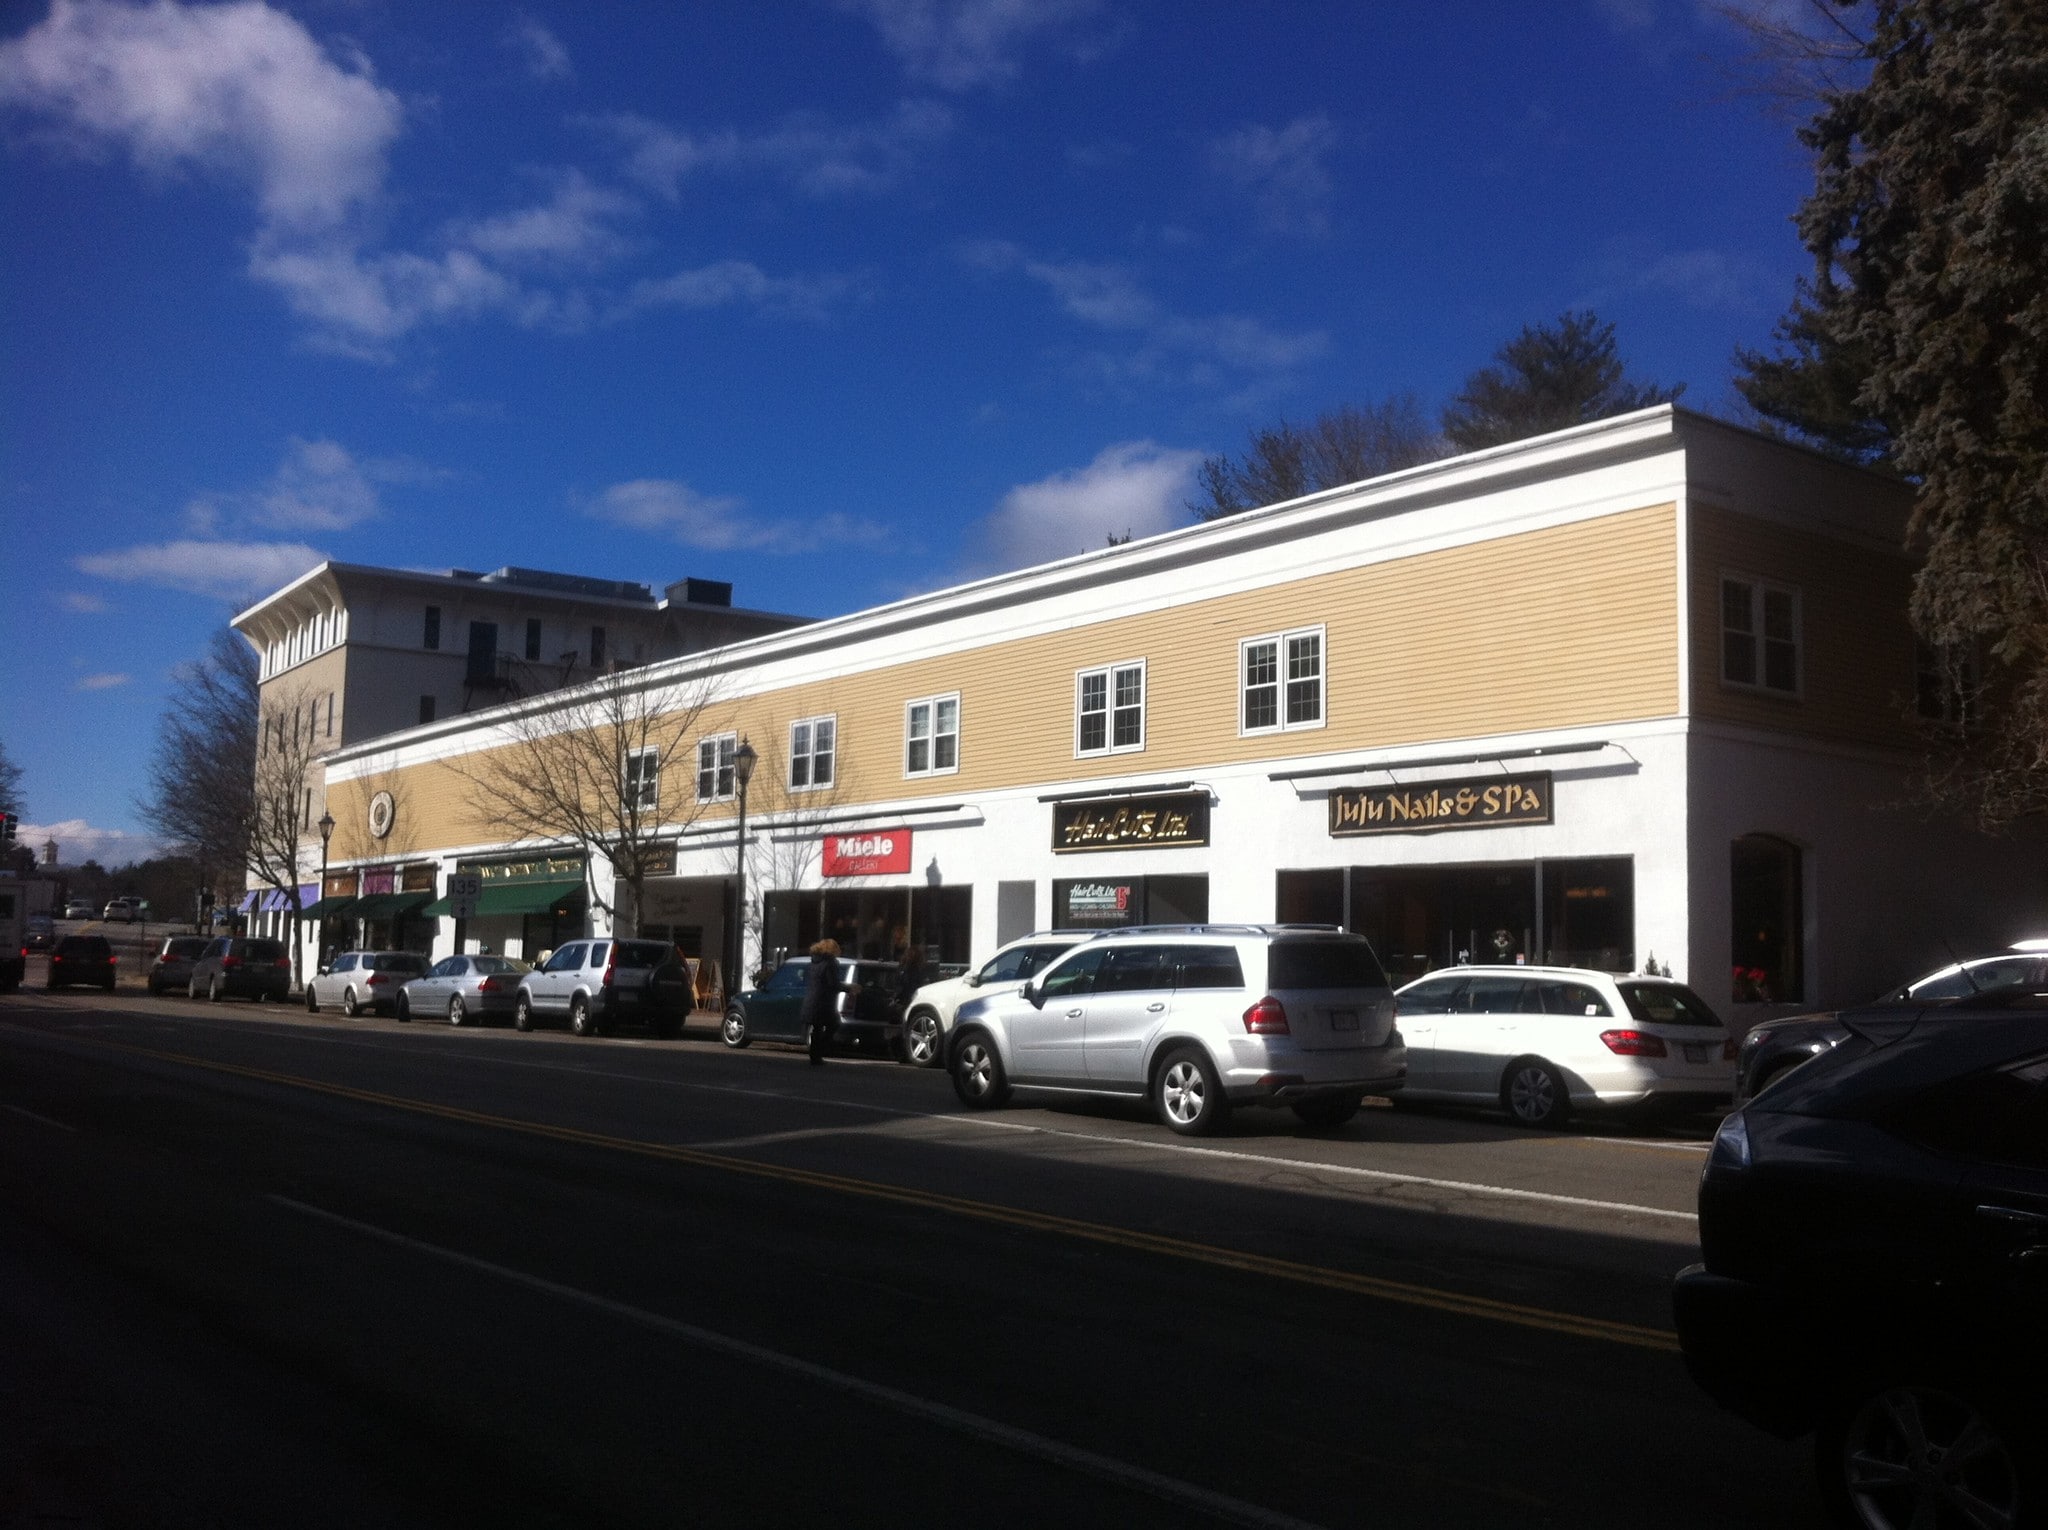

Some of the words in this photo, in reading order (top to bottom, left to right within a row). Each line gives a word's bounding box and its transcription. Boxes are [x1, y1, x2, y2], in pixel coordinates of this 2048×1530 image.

[1387, 789, 1454, 822] Nails
[1455, 787, 1480, 816] &
[837, 835, 893, 857] Miele
[451, 879, 478, 895] 135
